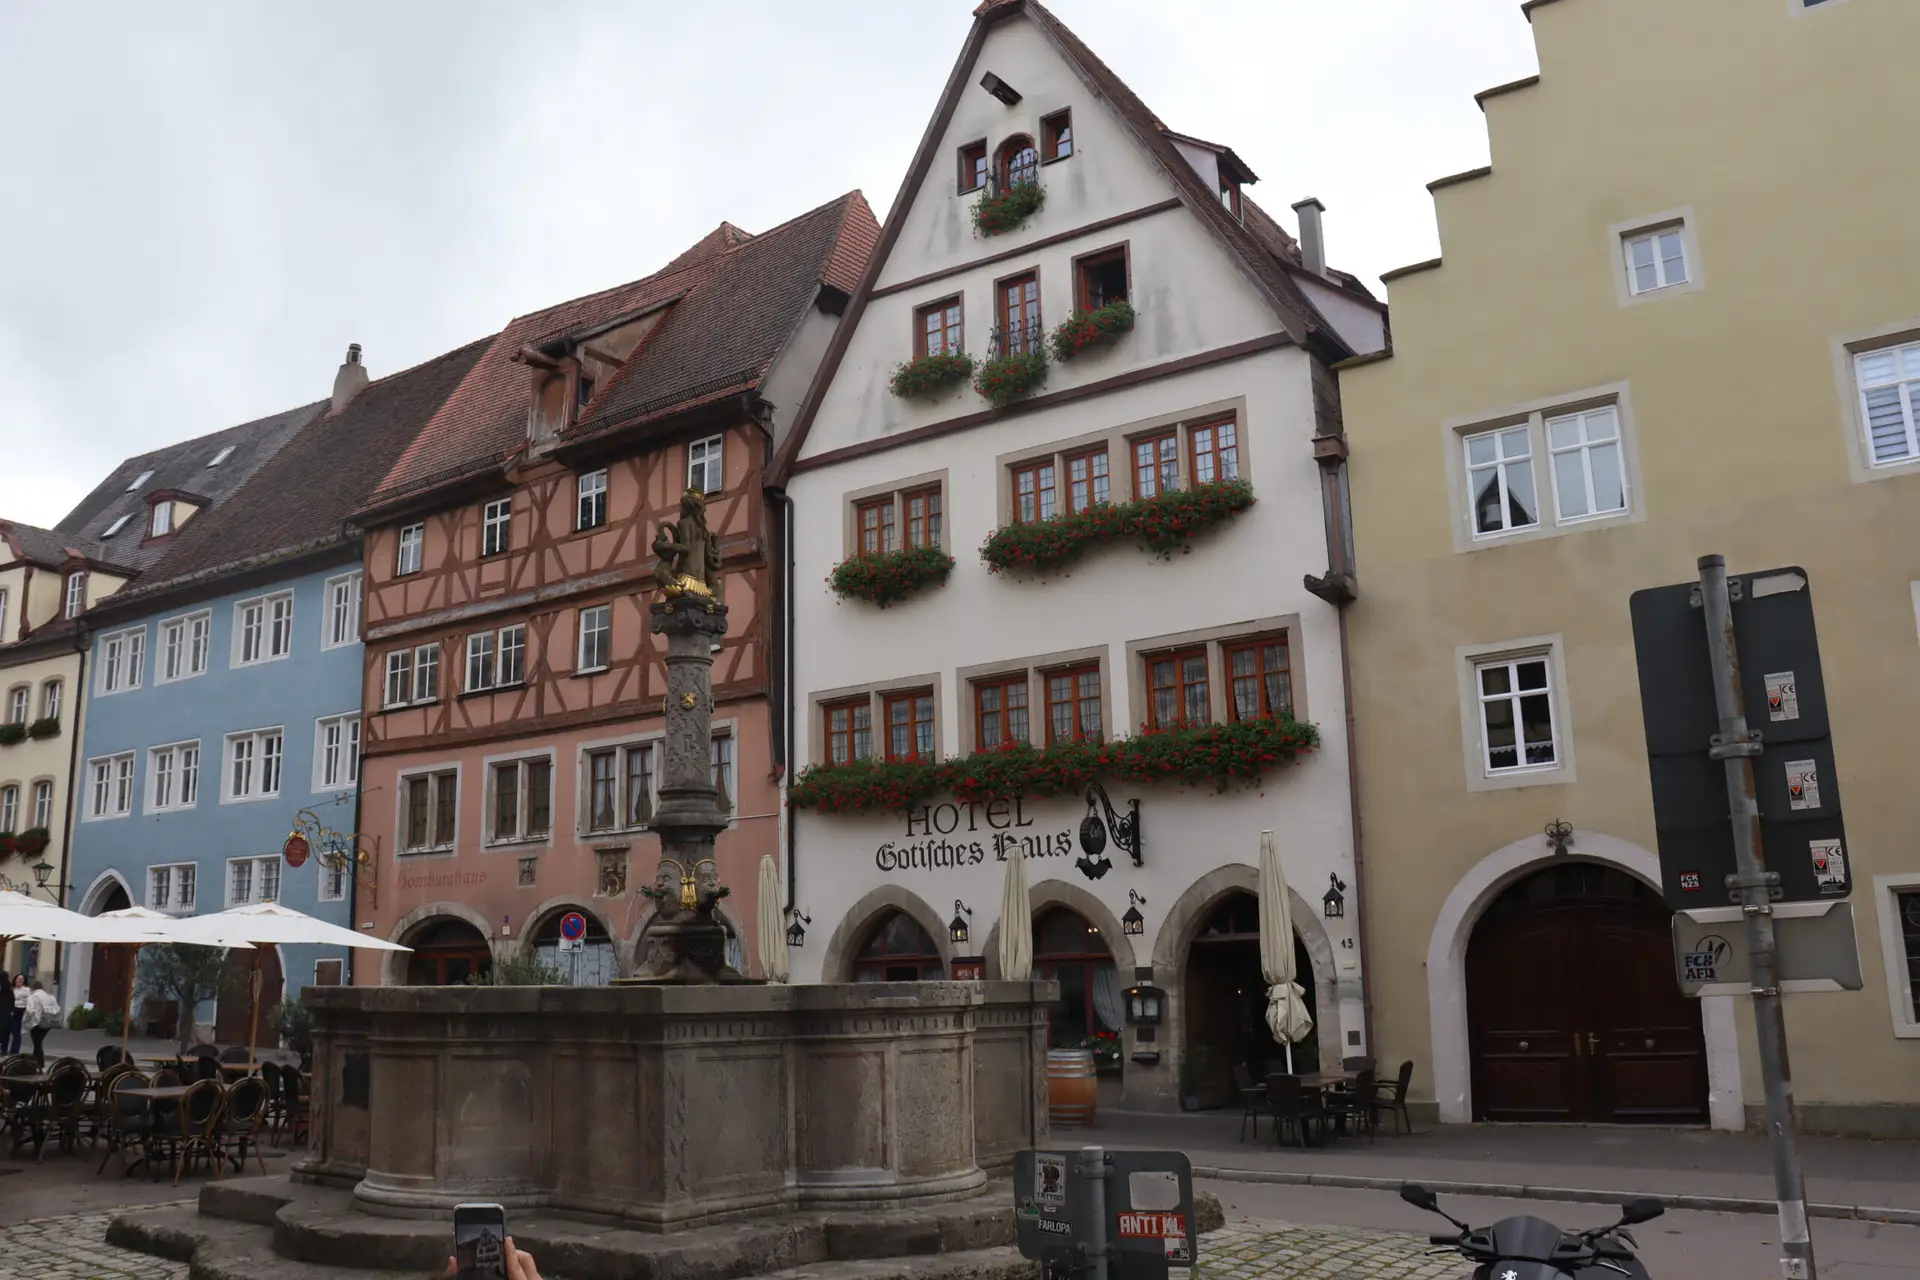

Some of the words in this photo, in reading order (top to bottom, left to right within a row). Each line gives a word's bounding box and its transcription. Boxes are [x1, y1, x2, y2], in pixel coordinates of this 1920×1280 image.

[905, 796, 1034, 837] HOTEL
[993, 829, 1072, 862] Haus
[1680, 874, 1699, 882] FCK
[1681, 881, 1700, 889] NZS
[1341, 938, 1354, 949] 13
[1036, 1192, 1064, 1202] TATTOO
[1038, 1219, 1071, 1235] FARLOPA
[1119, 1215, 1158, 1234] ANTI
